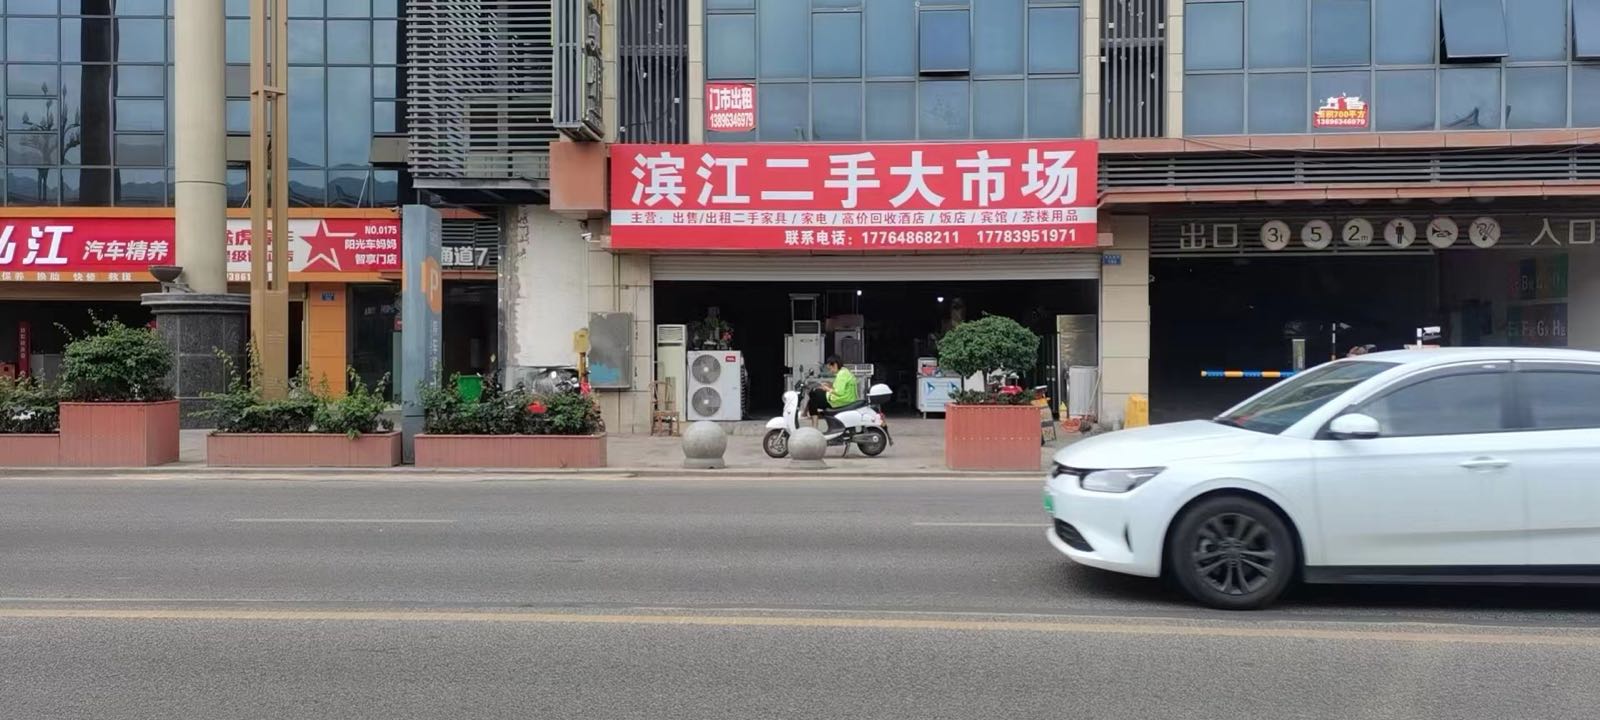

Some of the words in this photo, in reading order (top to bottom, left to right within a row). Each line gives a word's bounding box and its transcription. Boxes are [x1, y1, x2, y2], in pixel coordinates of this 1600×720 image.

[709, 87, 753, 111] 门市出租
[631, 149, 1078, 209] 滨江二手大市场
[364, 225, 397, 235] NO.0175
[861, 230, 959, 245] 17764868211
[976, 229, 1077, 243] 17783951971
[1180, 223, 1238, 248] 出口
[1310, 226, 1322, 241] 5
[1530, 217, 1596, 244] 入口
[82, 240, 169, 261] 汽车精养
[344, 238, 397, 250] 阳光车妈妈
[355, 253, 397, 265] 智享门店
